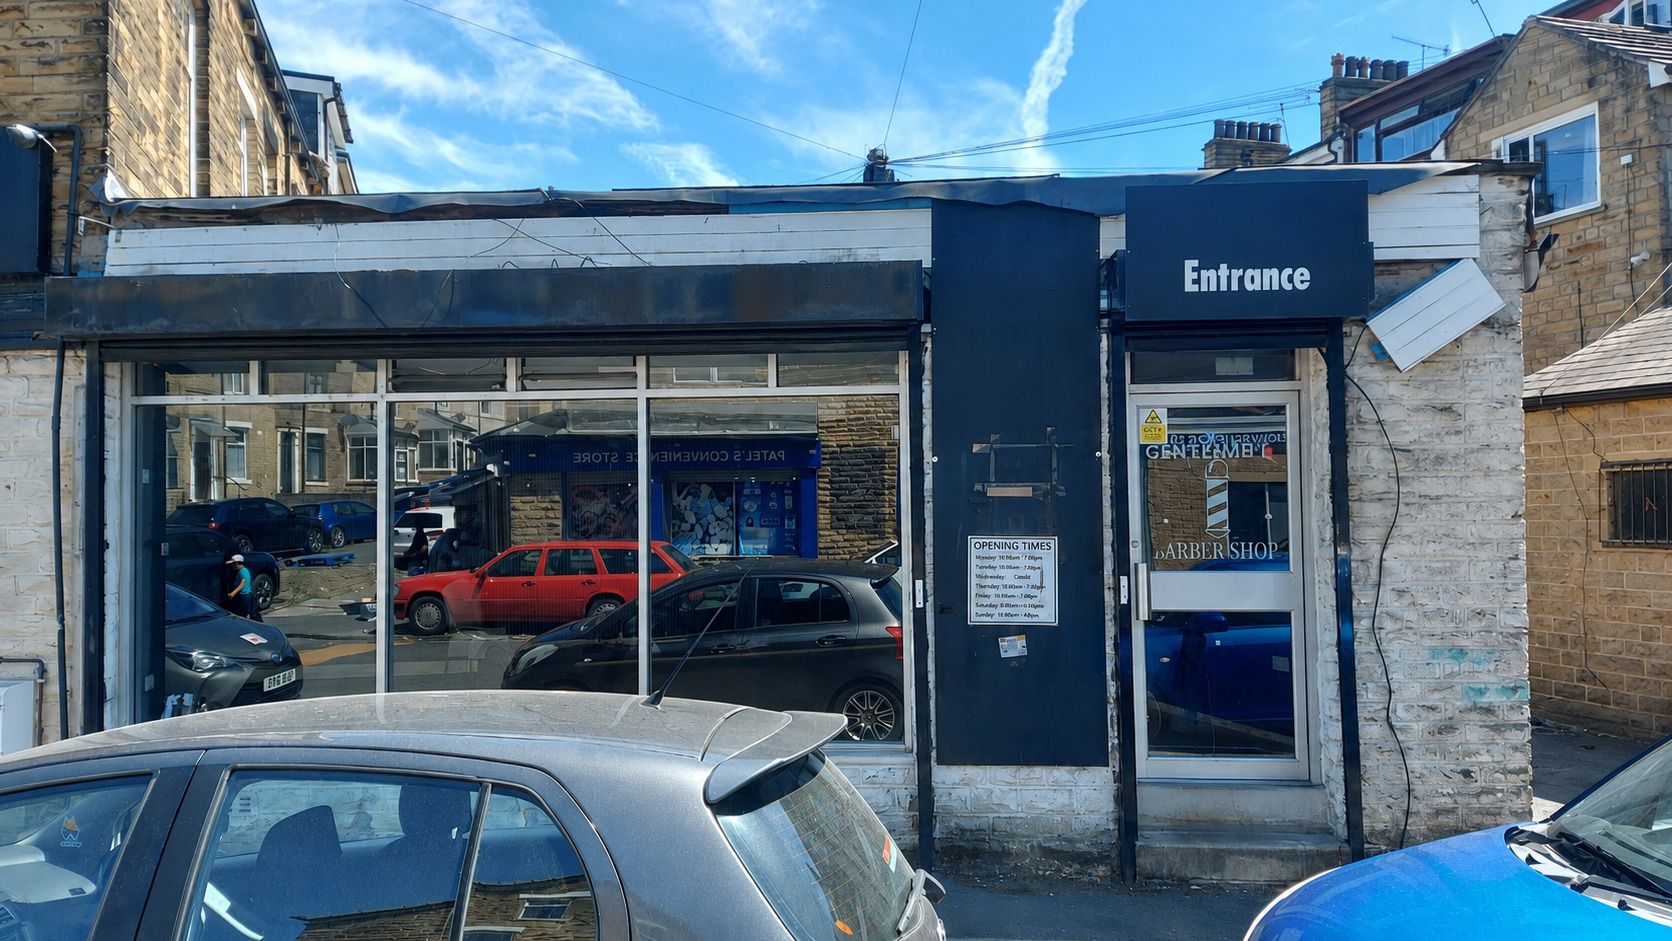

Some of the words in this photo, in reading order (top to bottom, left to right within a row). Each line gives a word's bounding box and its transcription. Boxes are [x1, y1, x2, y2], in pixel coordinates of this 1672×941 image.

[1184, 259, 1311, 292] Entrance
[974, 541, 1019, 550] OPENING
[1022, 541, 1052, 550] TIMES
[1230, 542, 1278, 560] SHOP
